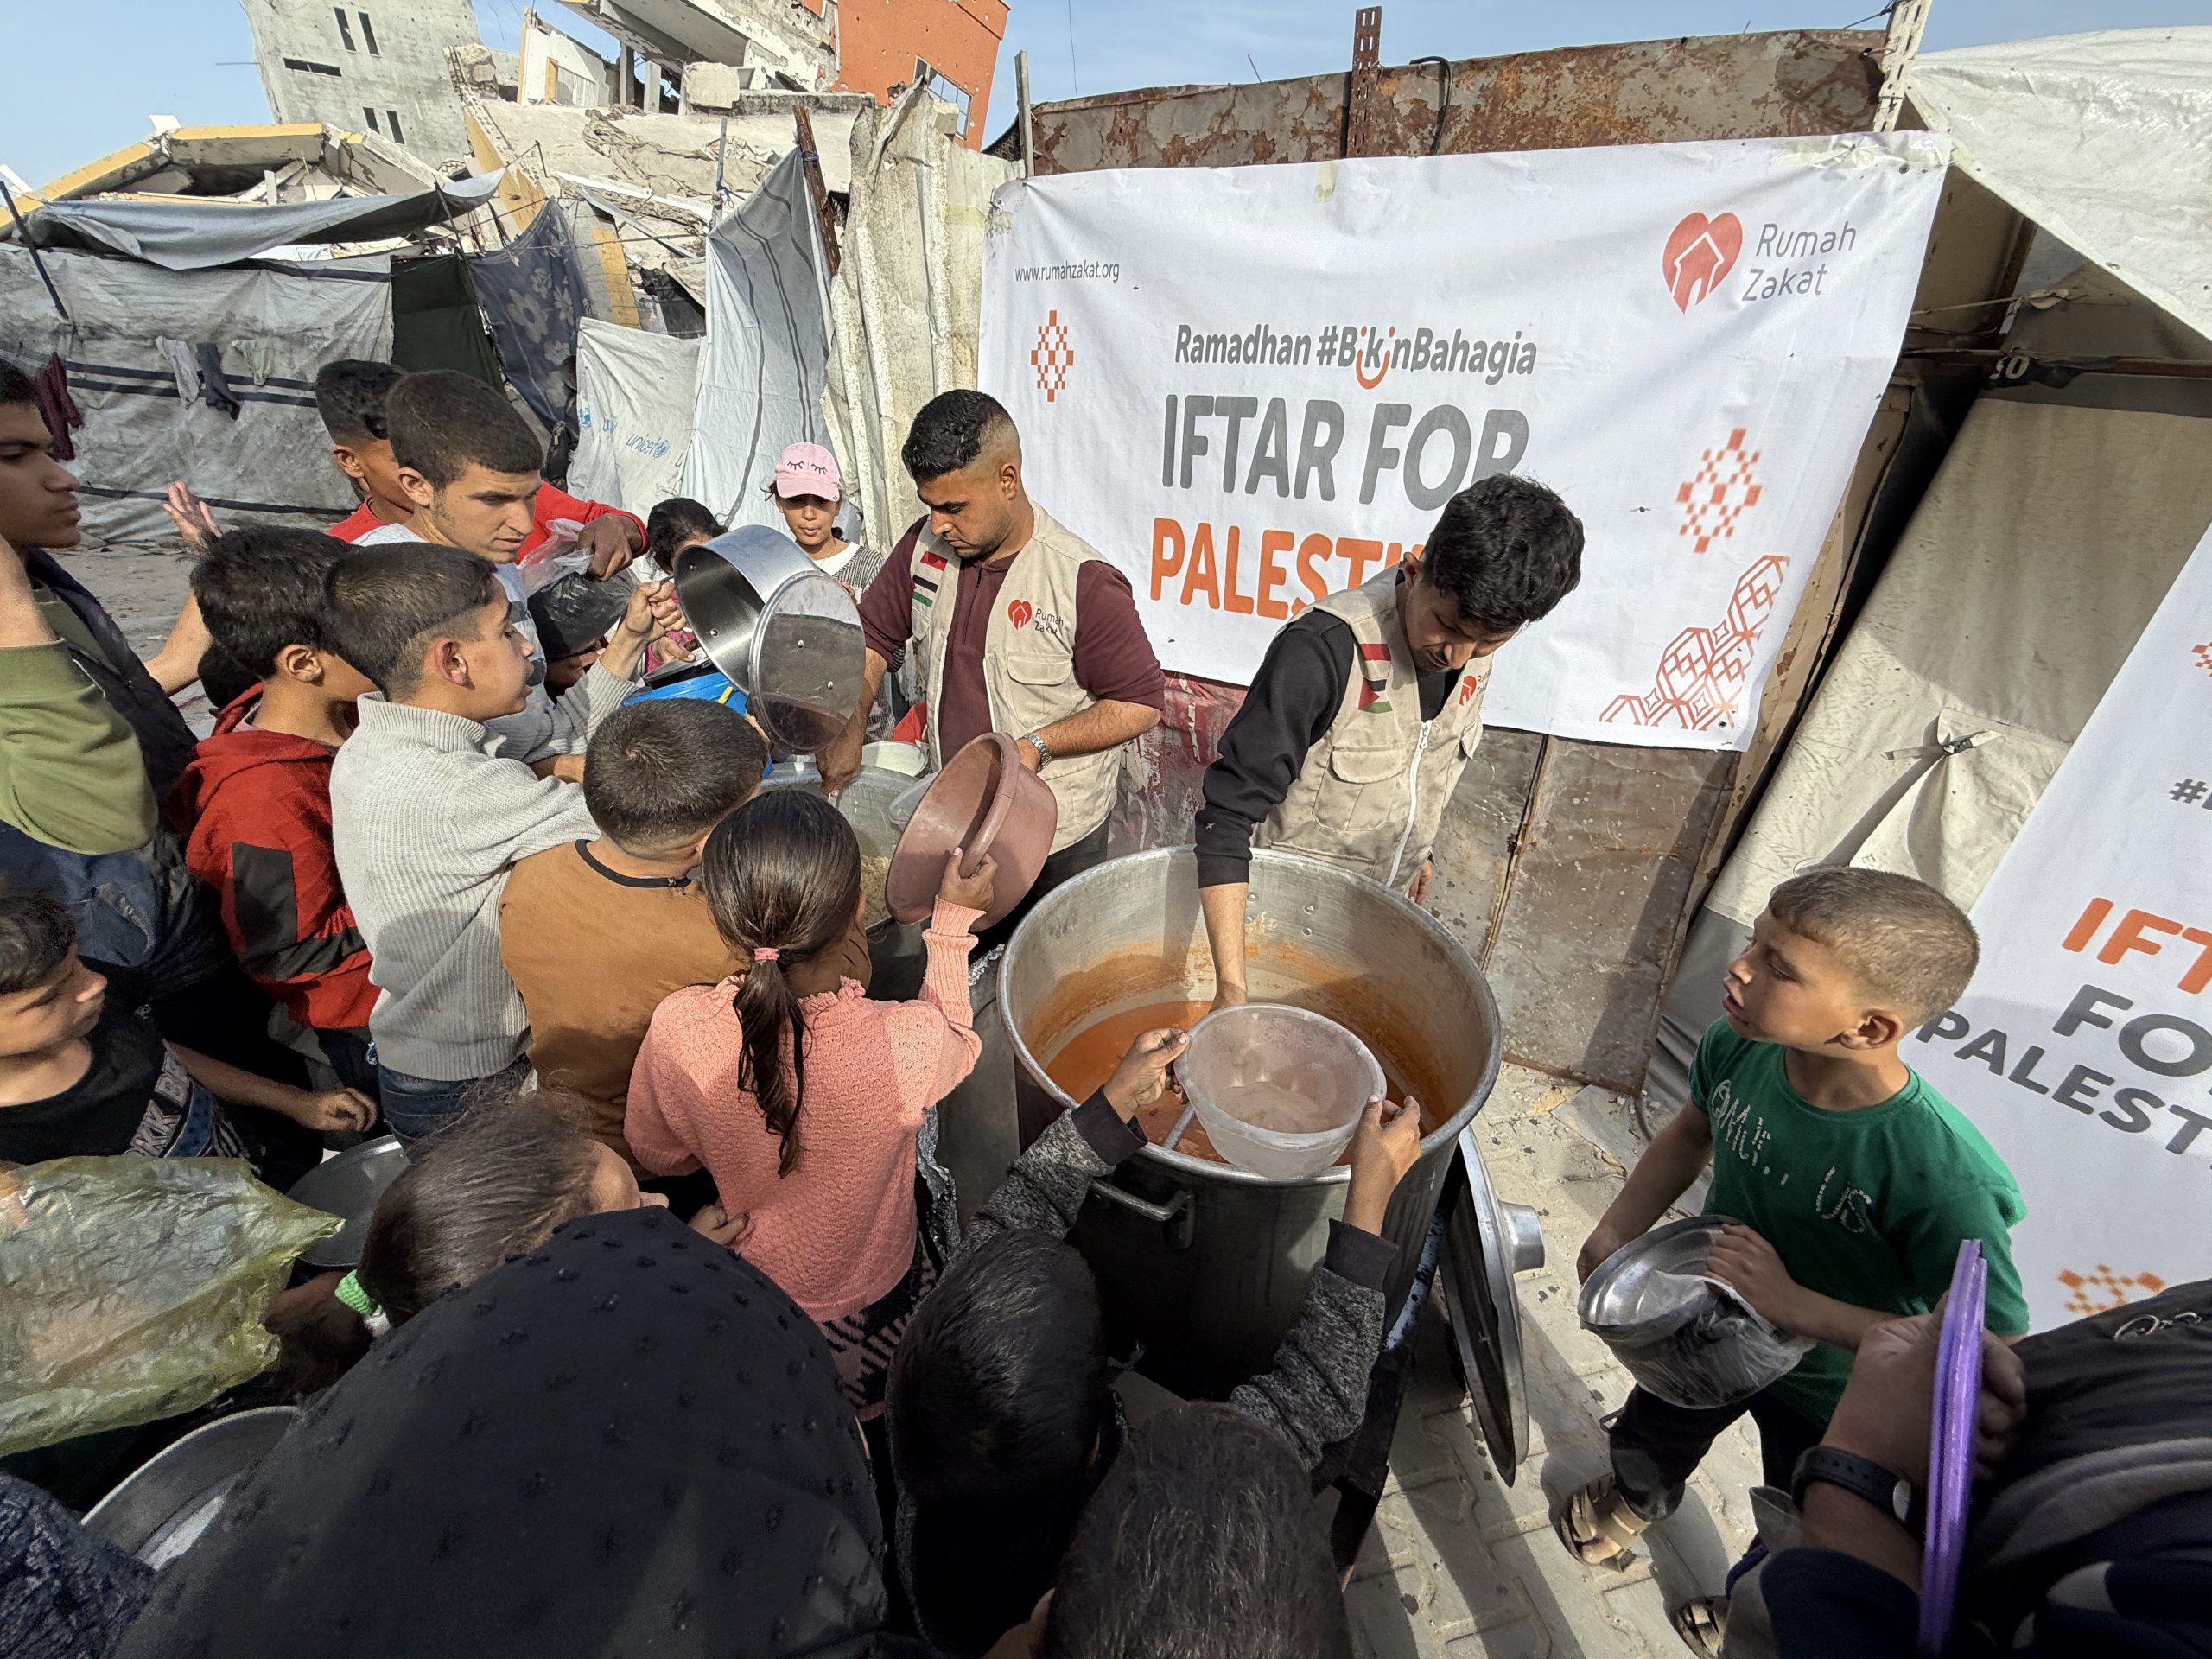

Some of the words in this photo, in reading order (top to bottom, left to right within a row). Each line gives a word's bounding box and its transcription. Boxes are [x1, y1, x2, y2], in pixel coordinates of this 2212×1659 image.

[1755, 220, 1857, 257] Rumah
[1014, 258, 1120, 283] www.rumahzakat.org
[1741, 263, 1828, 302] Zakat
[1174, 323, 1312, 366] Ramadhan
[1316, 324, 1538, 390] #BikinBahagia
[626, 433, 662, 455] unicef
[1161, 393, 1345, 502] IFTAR
[1358, 402, 1529, 512] FOR
[1149, 518, 1425, 620] PALEST
[1035, 607, 1065, 628] Rumah
[2051, 983, 2212, 1096] FO
[1915, 1010, 2212, 1170] PALEST
